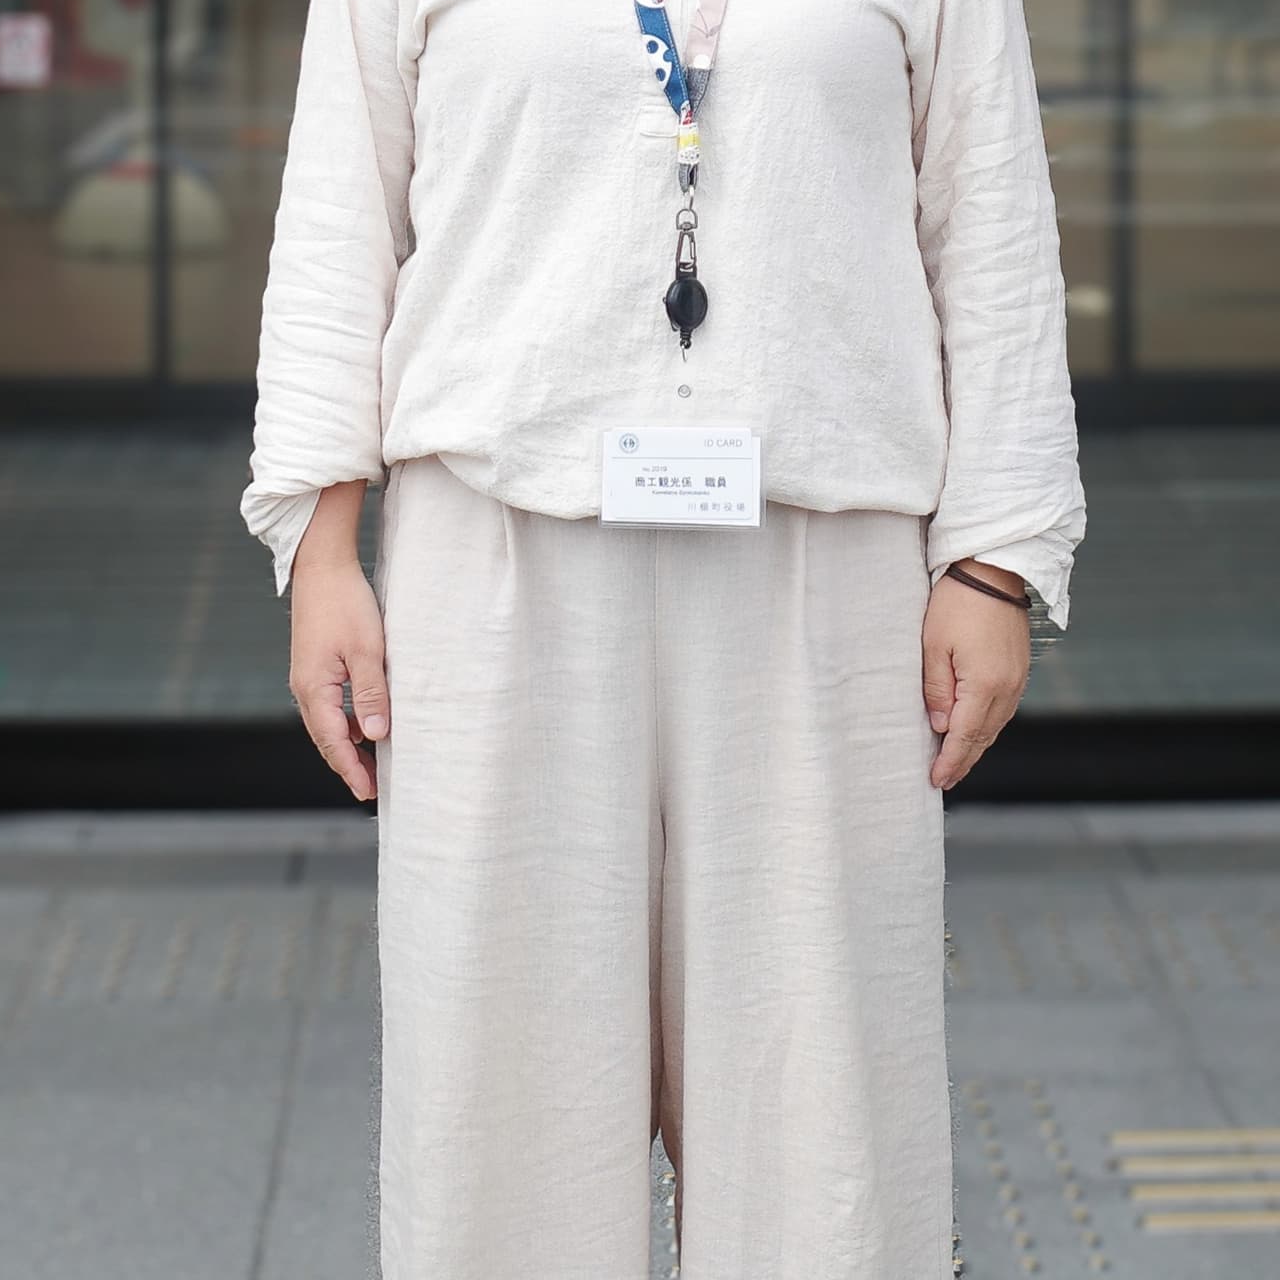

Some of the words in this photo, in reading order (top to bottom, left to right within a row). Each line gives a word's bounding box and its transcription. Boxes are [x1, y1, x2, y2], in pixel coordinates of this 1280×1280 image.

[703, 438, 714, 448] ID
[716, 438, 743, 448] CARD
[634, 476, 693, 488] 商工観光係
[704, 475, 727, 489] 職員
